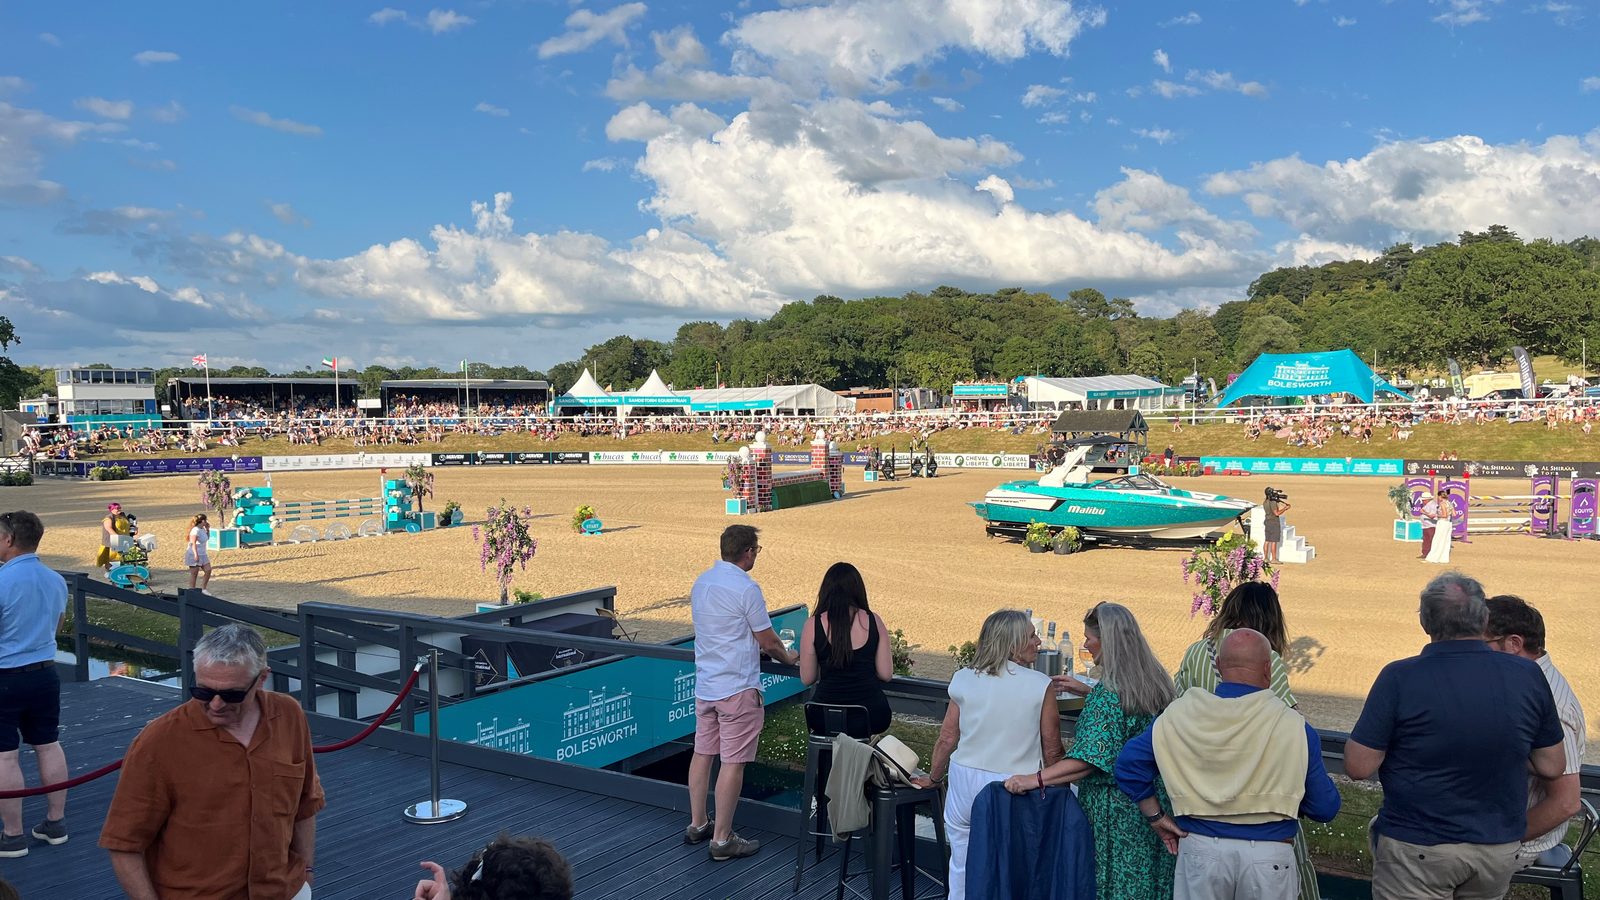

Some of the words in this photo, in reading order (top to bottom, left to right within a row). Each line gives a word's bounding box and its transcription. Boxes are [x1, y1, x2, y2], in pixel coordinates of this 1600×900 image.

[1268, 380, 1332, 388] BOLESWORTH
[602, 452, 624, 460] bucas
[678, 452, 699, 460] bucas
[1067, 505, 1106, 515] Malibu
[556, 722, 638, 761] BOLESWORTH
